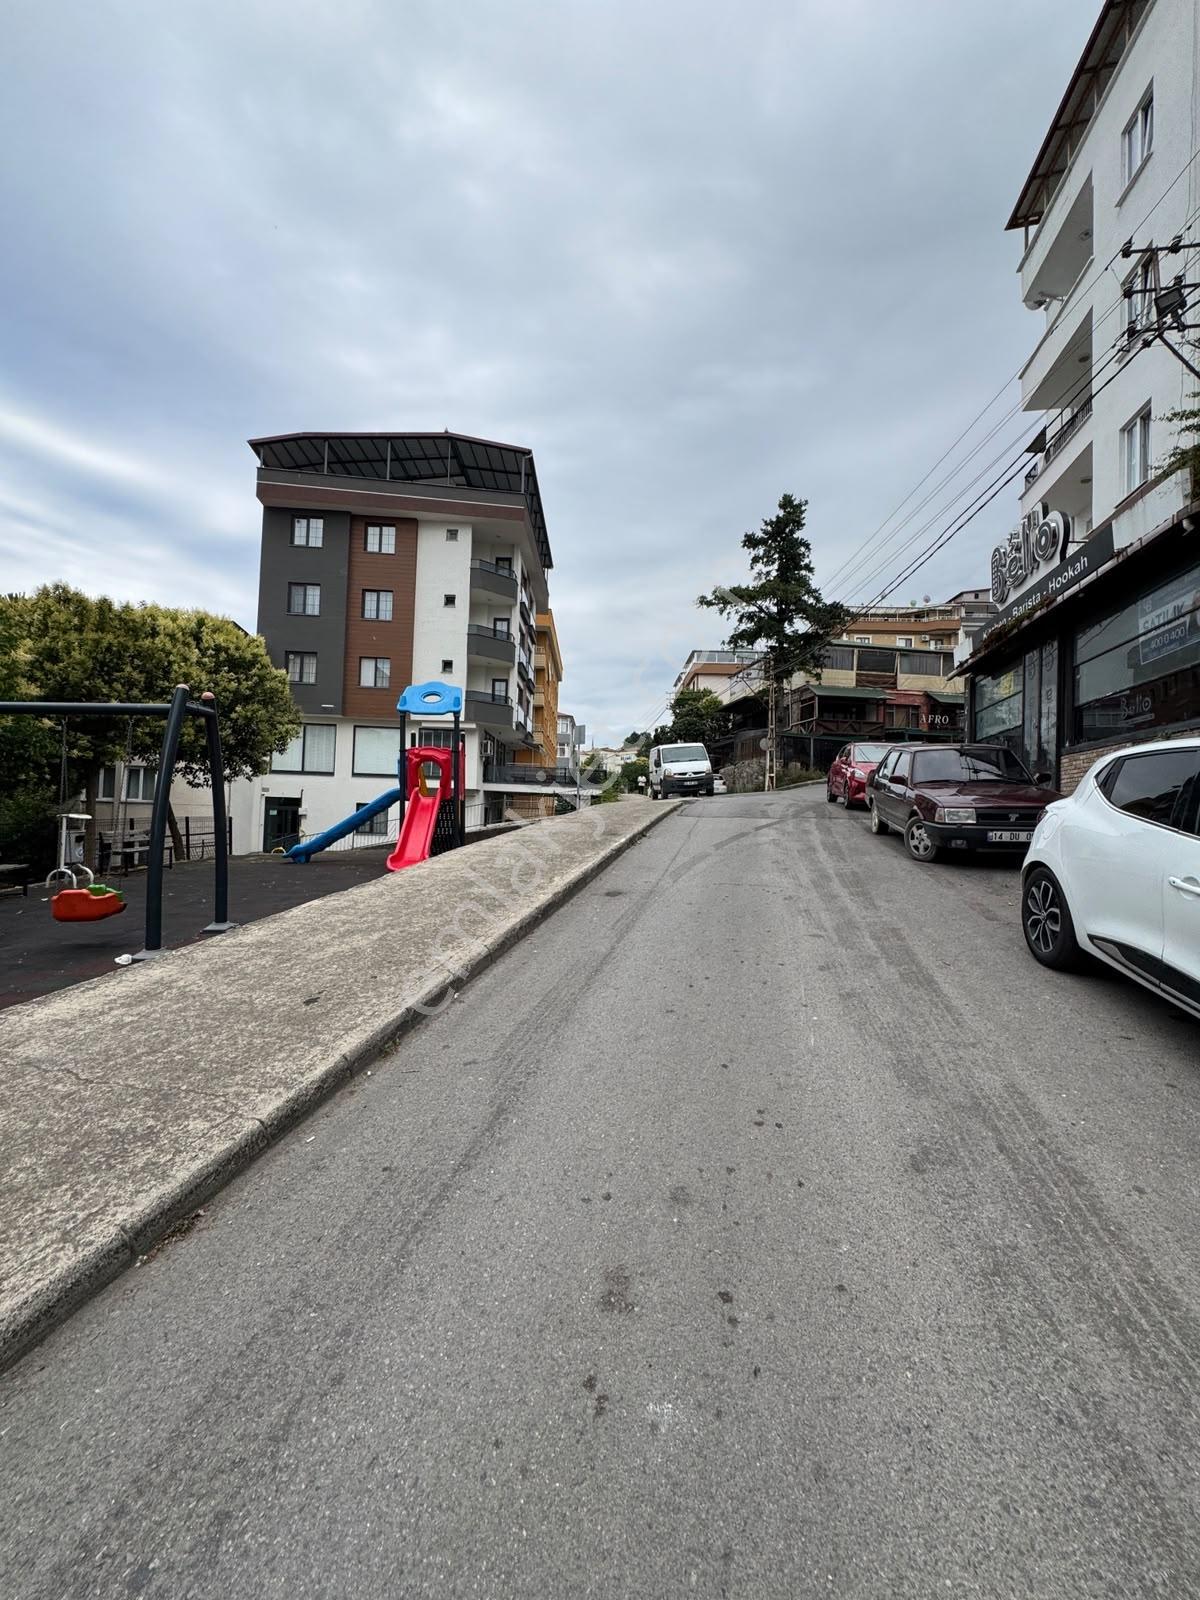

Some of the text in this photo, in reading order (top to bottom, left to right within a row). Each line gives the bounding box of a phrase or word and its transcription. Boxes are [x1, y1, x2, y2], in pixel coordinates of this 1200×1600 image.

[1012, 592, 1041, 617] Barista
[1048, 556, 1088, 592] Hookah
[920, 713, 949, 725] AFRO
[994, 832, 1003, 840] 14
